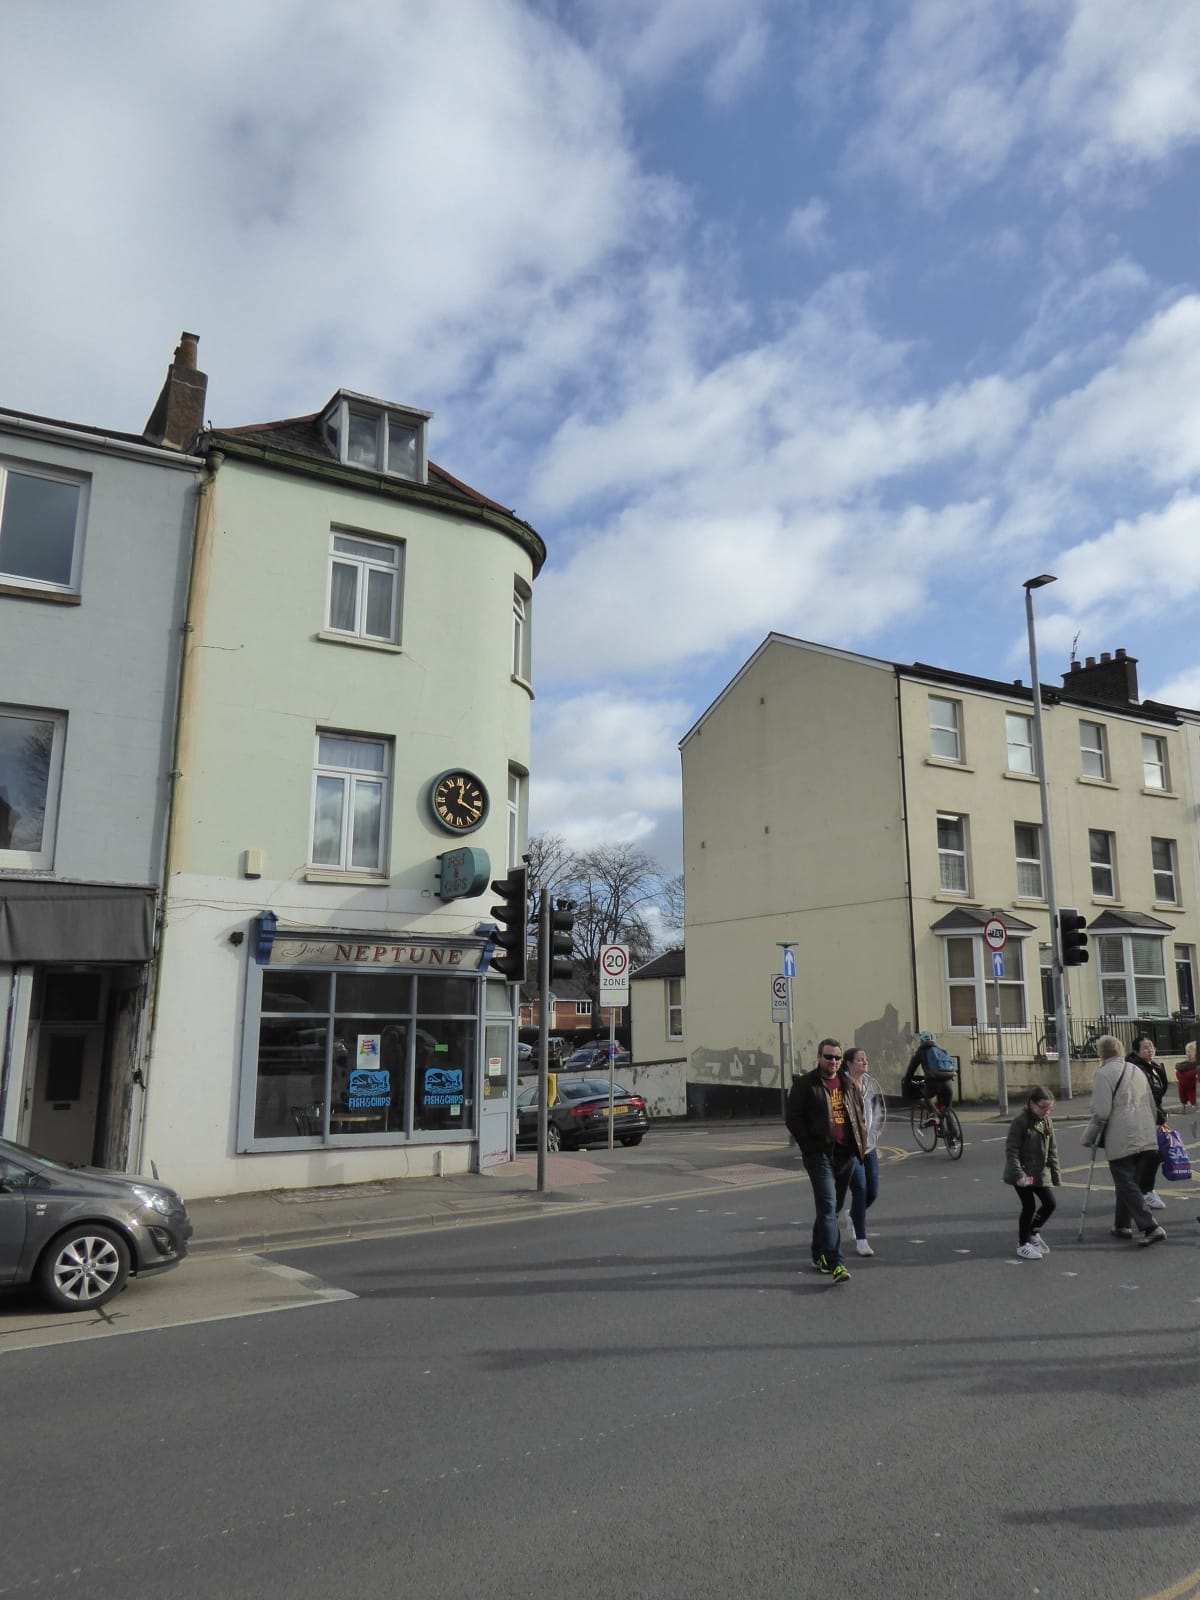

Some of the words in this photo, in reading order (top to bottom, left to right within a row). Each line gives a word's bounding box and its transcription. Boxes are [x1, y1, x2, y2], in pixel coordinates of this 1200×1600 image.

[334, 944, 463, 965] NEPTUNE
[606, 955, 624, 968] 20
[603, 978, 626, 986] ZONE
